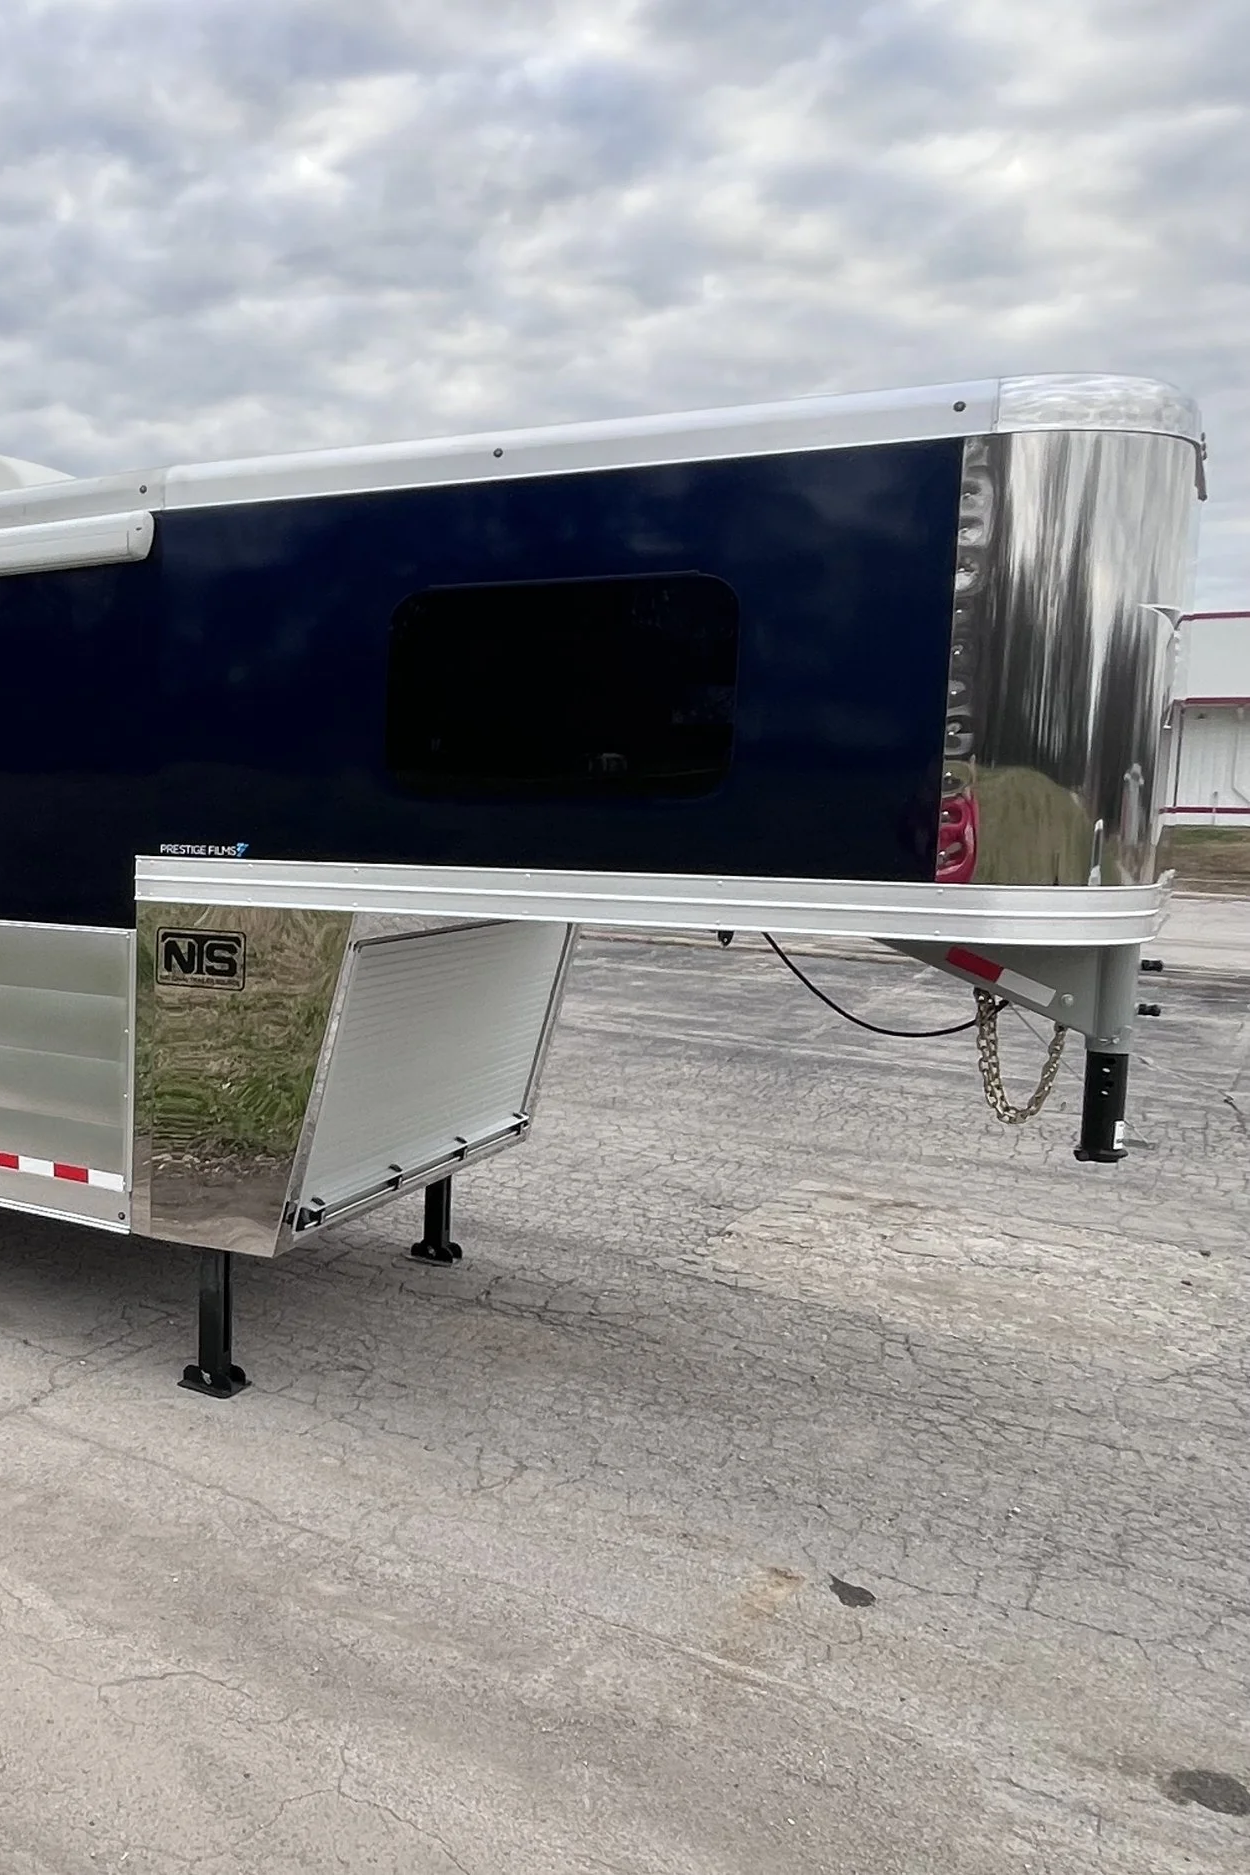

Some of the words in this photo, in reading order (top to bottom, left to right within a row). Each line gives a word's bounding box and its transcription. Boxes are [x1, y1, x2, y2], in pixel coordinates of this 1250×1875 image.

[159, 844, 207, 855] PRESTIGE
[208, 845, 237, 856] FILMS
[161, 932, 241, 977] NTS
